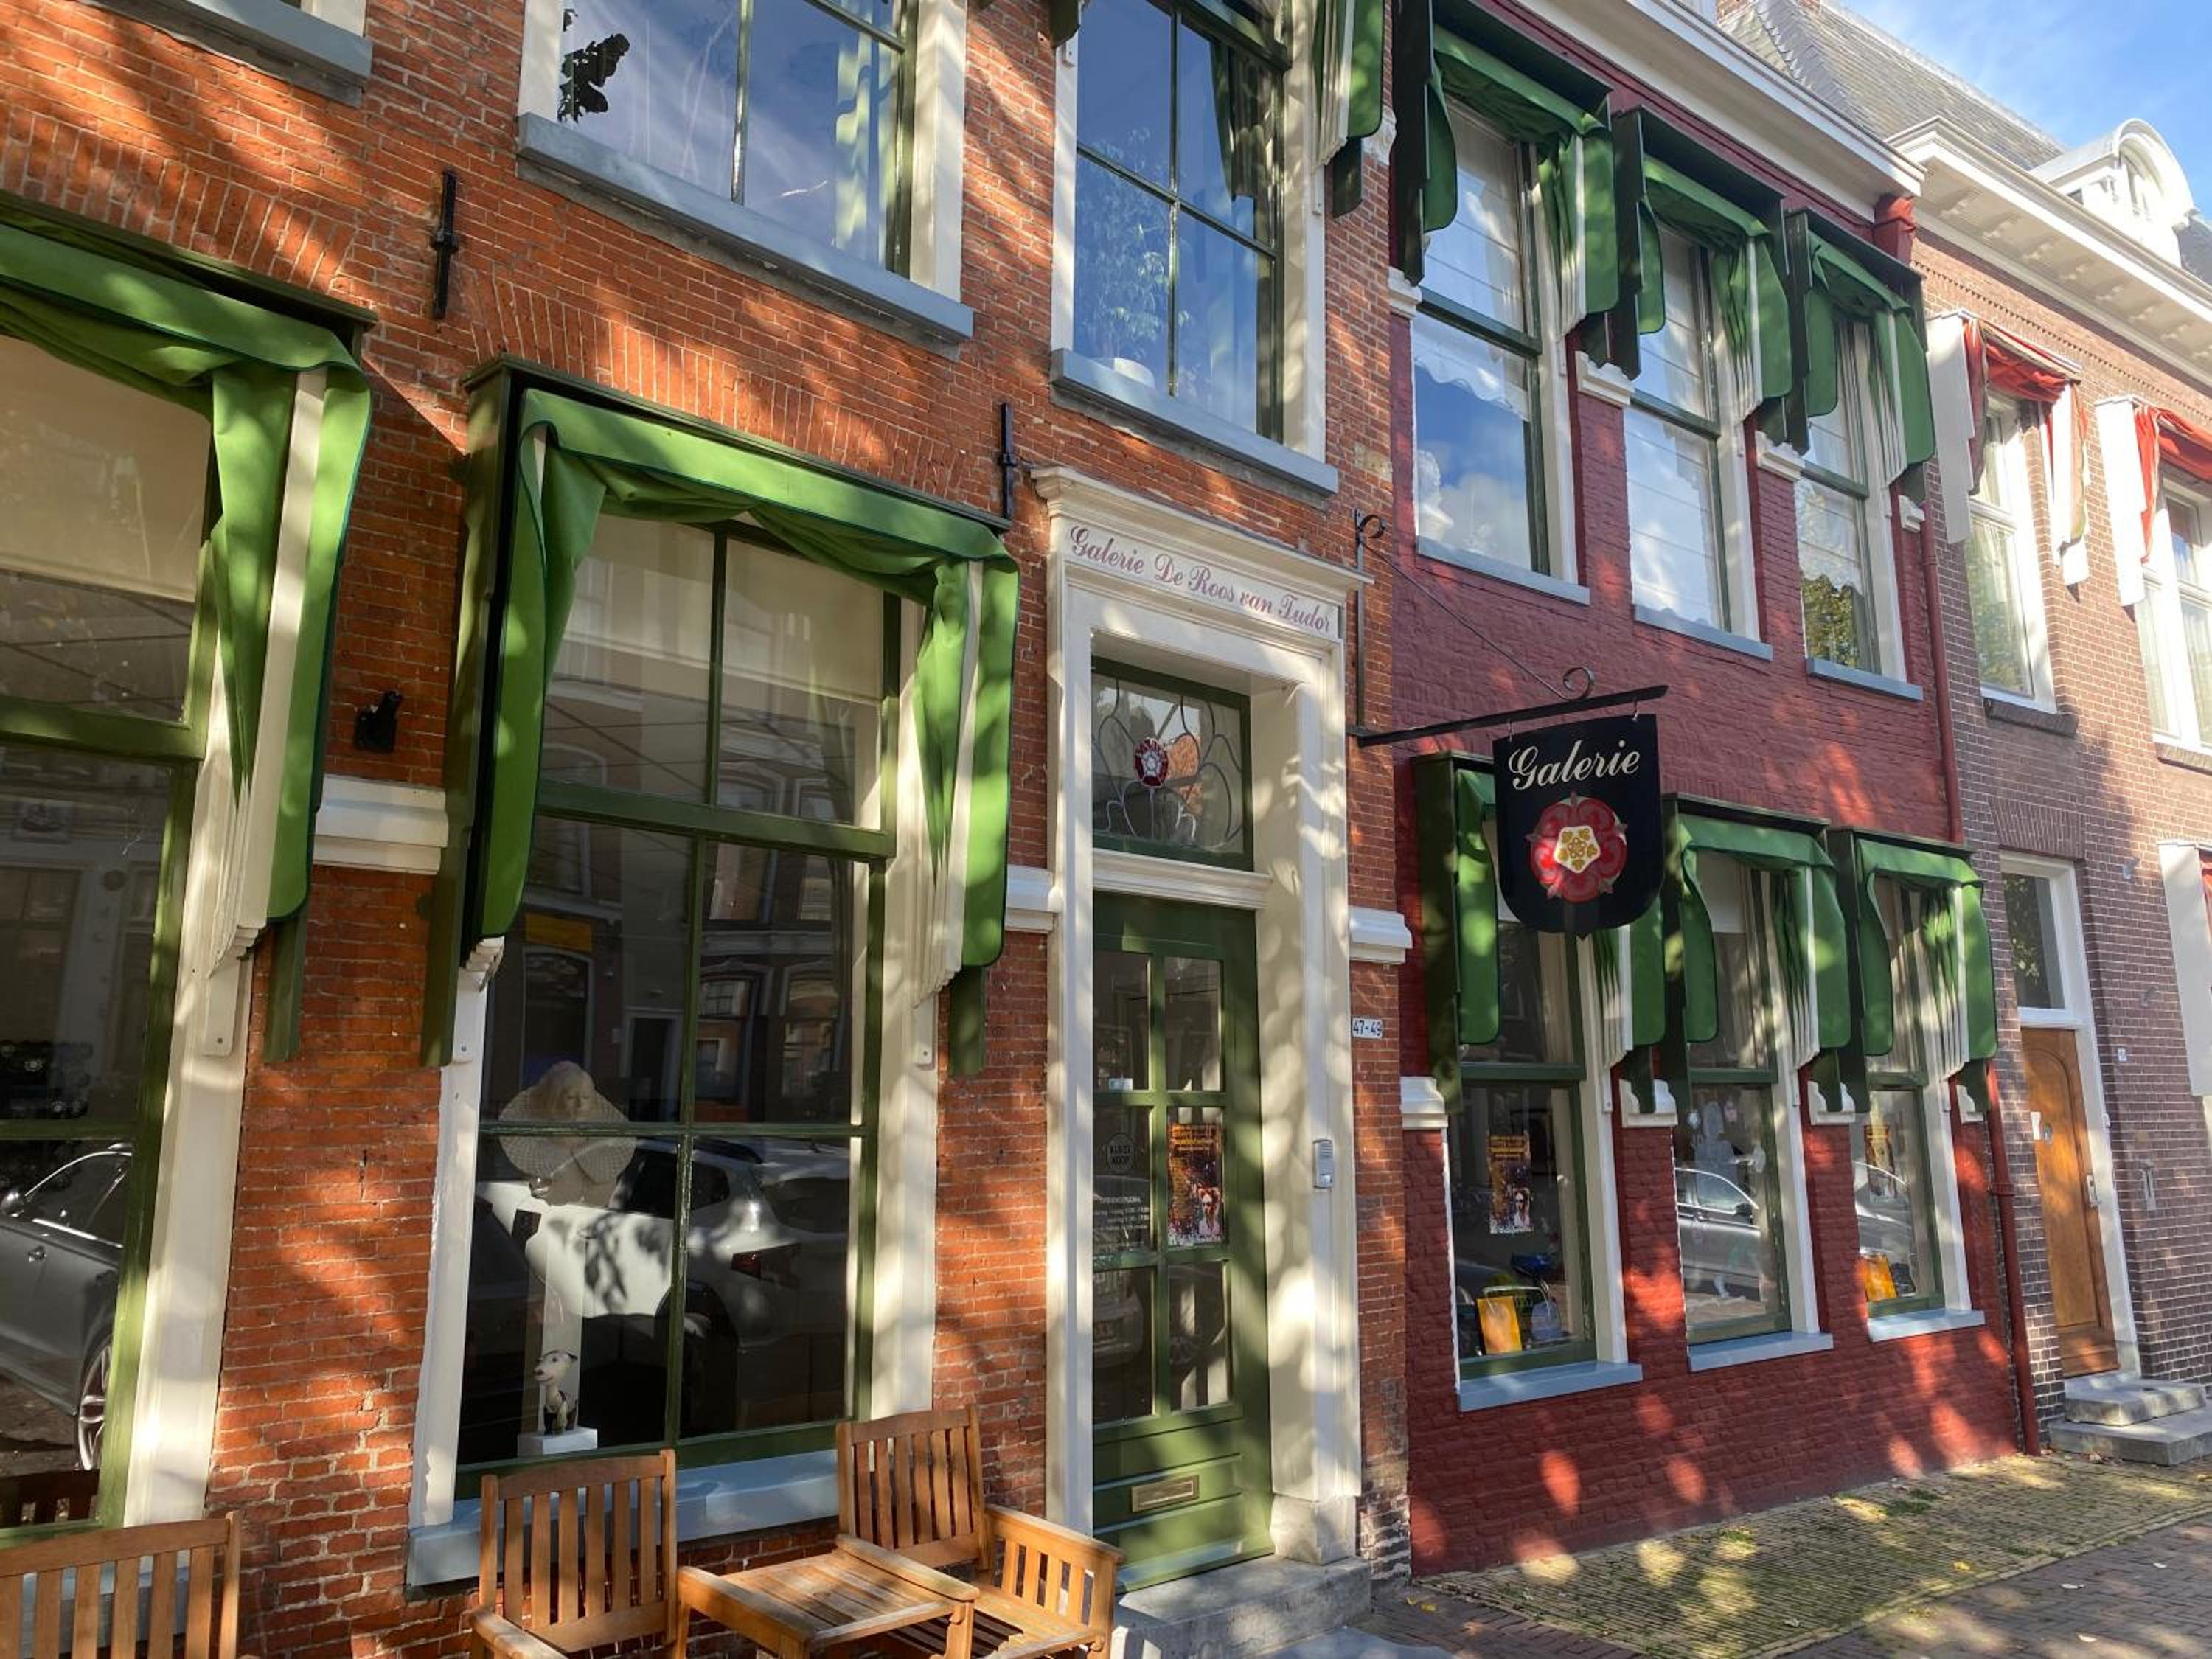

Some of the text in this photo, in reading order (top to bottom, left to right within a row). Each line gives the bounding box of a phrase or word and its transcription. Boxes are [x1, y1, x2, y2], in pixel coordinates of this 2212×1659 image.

[1070, 526, 1330, 632] Galerie De Roos van Tudor
[1508, 740, 1641, 790] Galerie
